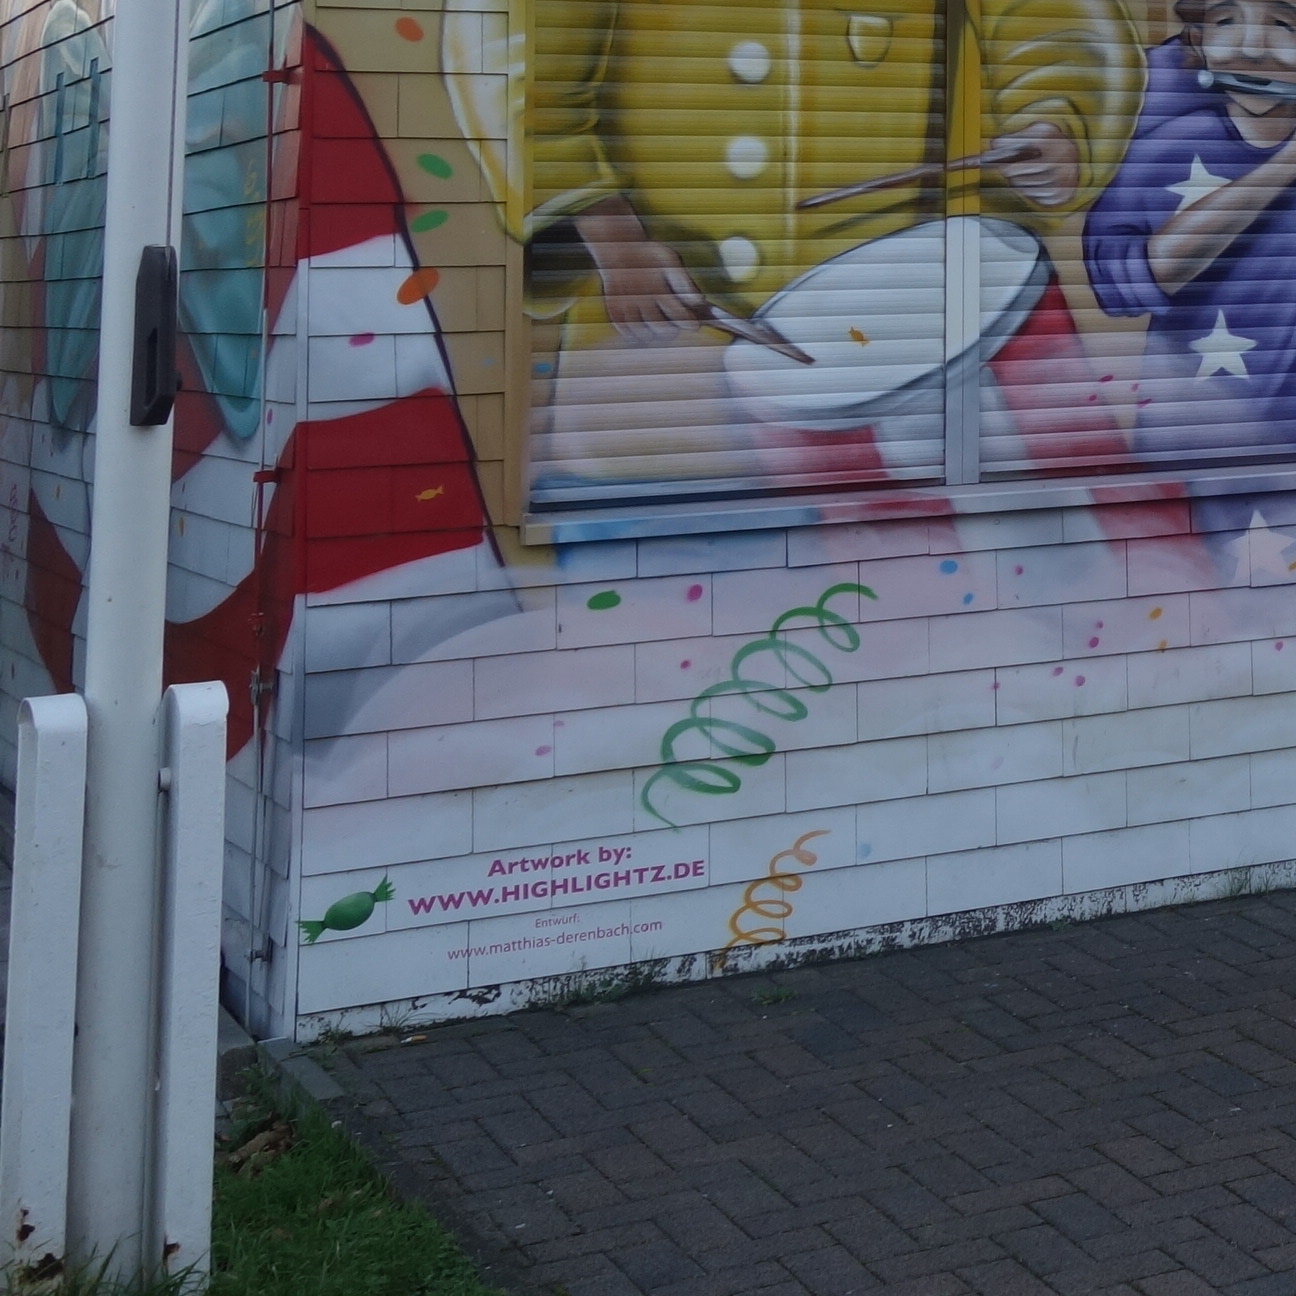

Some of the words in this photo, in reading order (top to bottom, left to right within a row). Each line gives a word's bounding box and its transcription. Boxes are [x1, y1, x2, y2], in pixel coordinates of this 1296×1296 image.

[487, 849, 590, 878] Artwork
[598, 846, 632, 866] by:
[407, 859, 705, 916] WWW.HIGHLIGHTZ.DE
[534, 913, 580, 929] Entwurf:
[447, 920, 663, 961] www.matthias-derenbach.com
